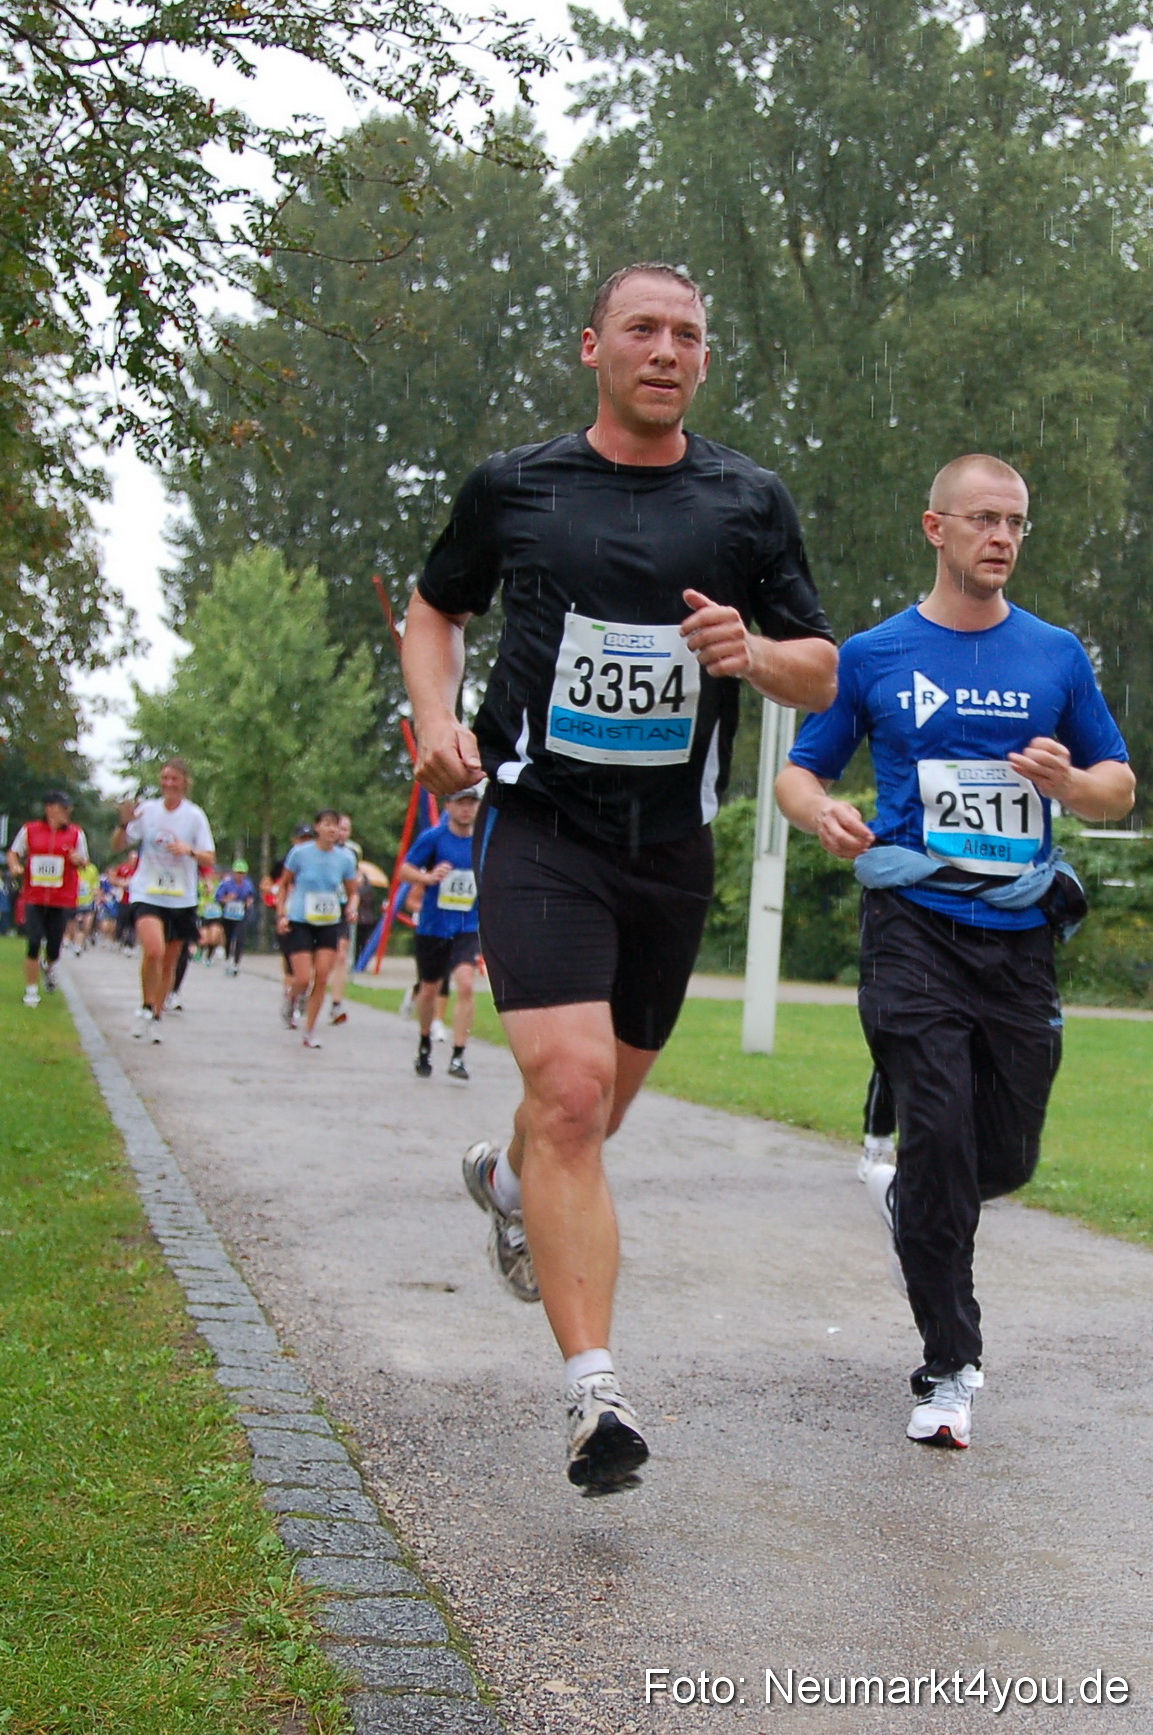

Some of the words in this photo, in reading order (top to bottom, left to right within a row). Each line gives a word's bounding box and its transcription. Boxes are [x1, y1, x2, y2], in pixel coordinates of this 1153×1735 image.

[568, 656, 687, 715] 3354
[955, 688, 1031, 709] PLAST
[555, 717, 686, 741] CHRISTIAN
[935, 790, 1029, 834] 2511
[962, 838, 1011, 862] Alexej
